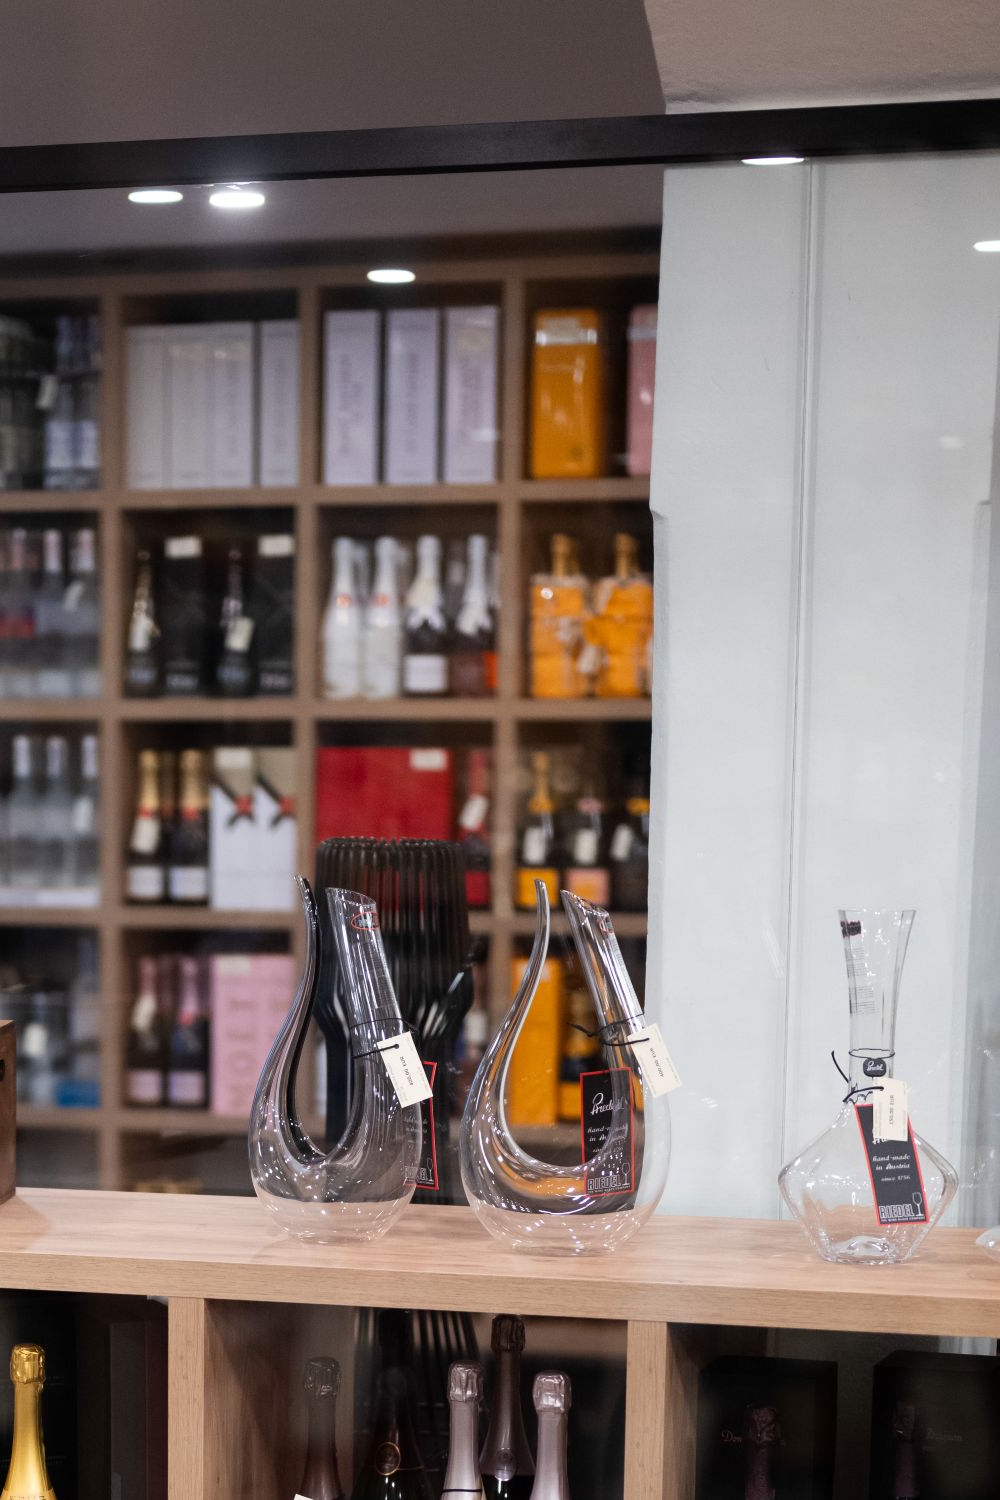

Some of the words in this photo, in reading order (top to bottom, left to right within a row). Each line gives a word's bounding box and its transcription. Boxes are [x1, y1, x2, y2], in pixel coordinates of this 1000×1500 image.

[872, 1153, 910, 1162] hand-made
[587, 1174, 621, 1191] RIEDEL
[879, 1204, 915, 1219] RIEDEL
